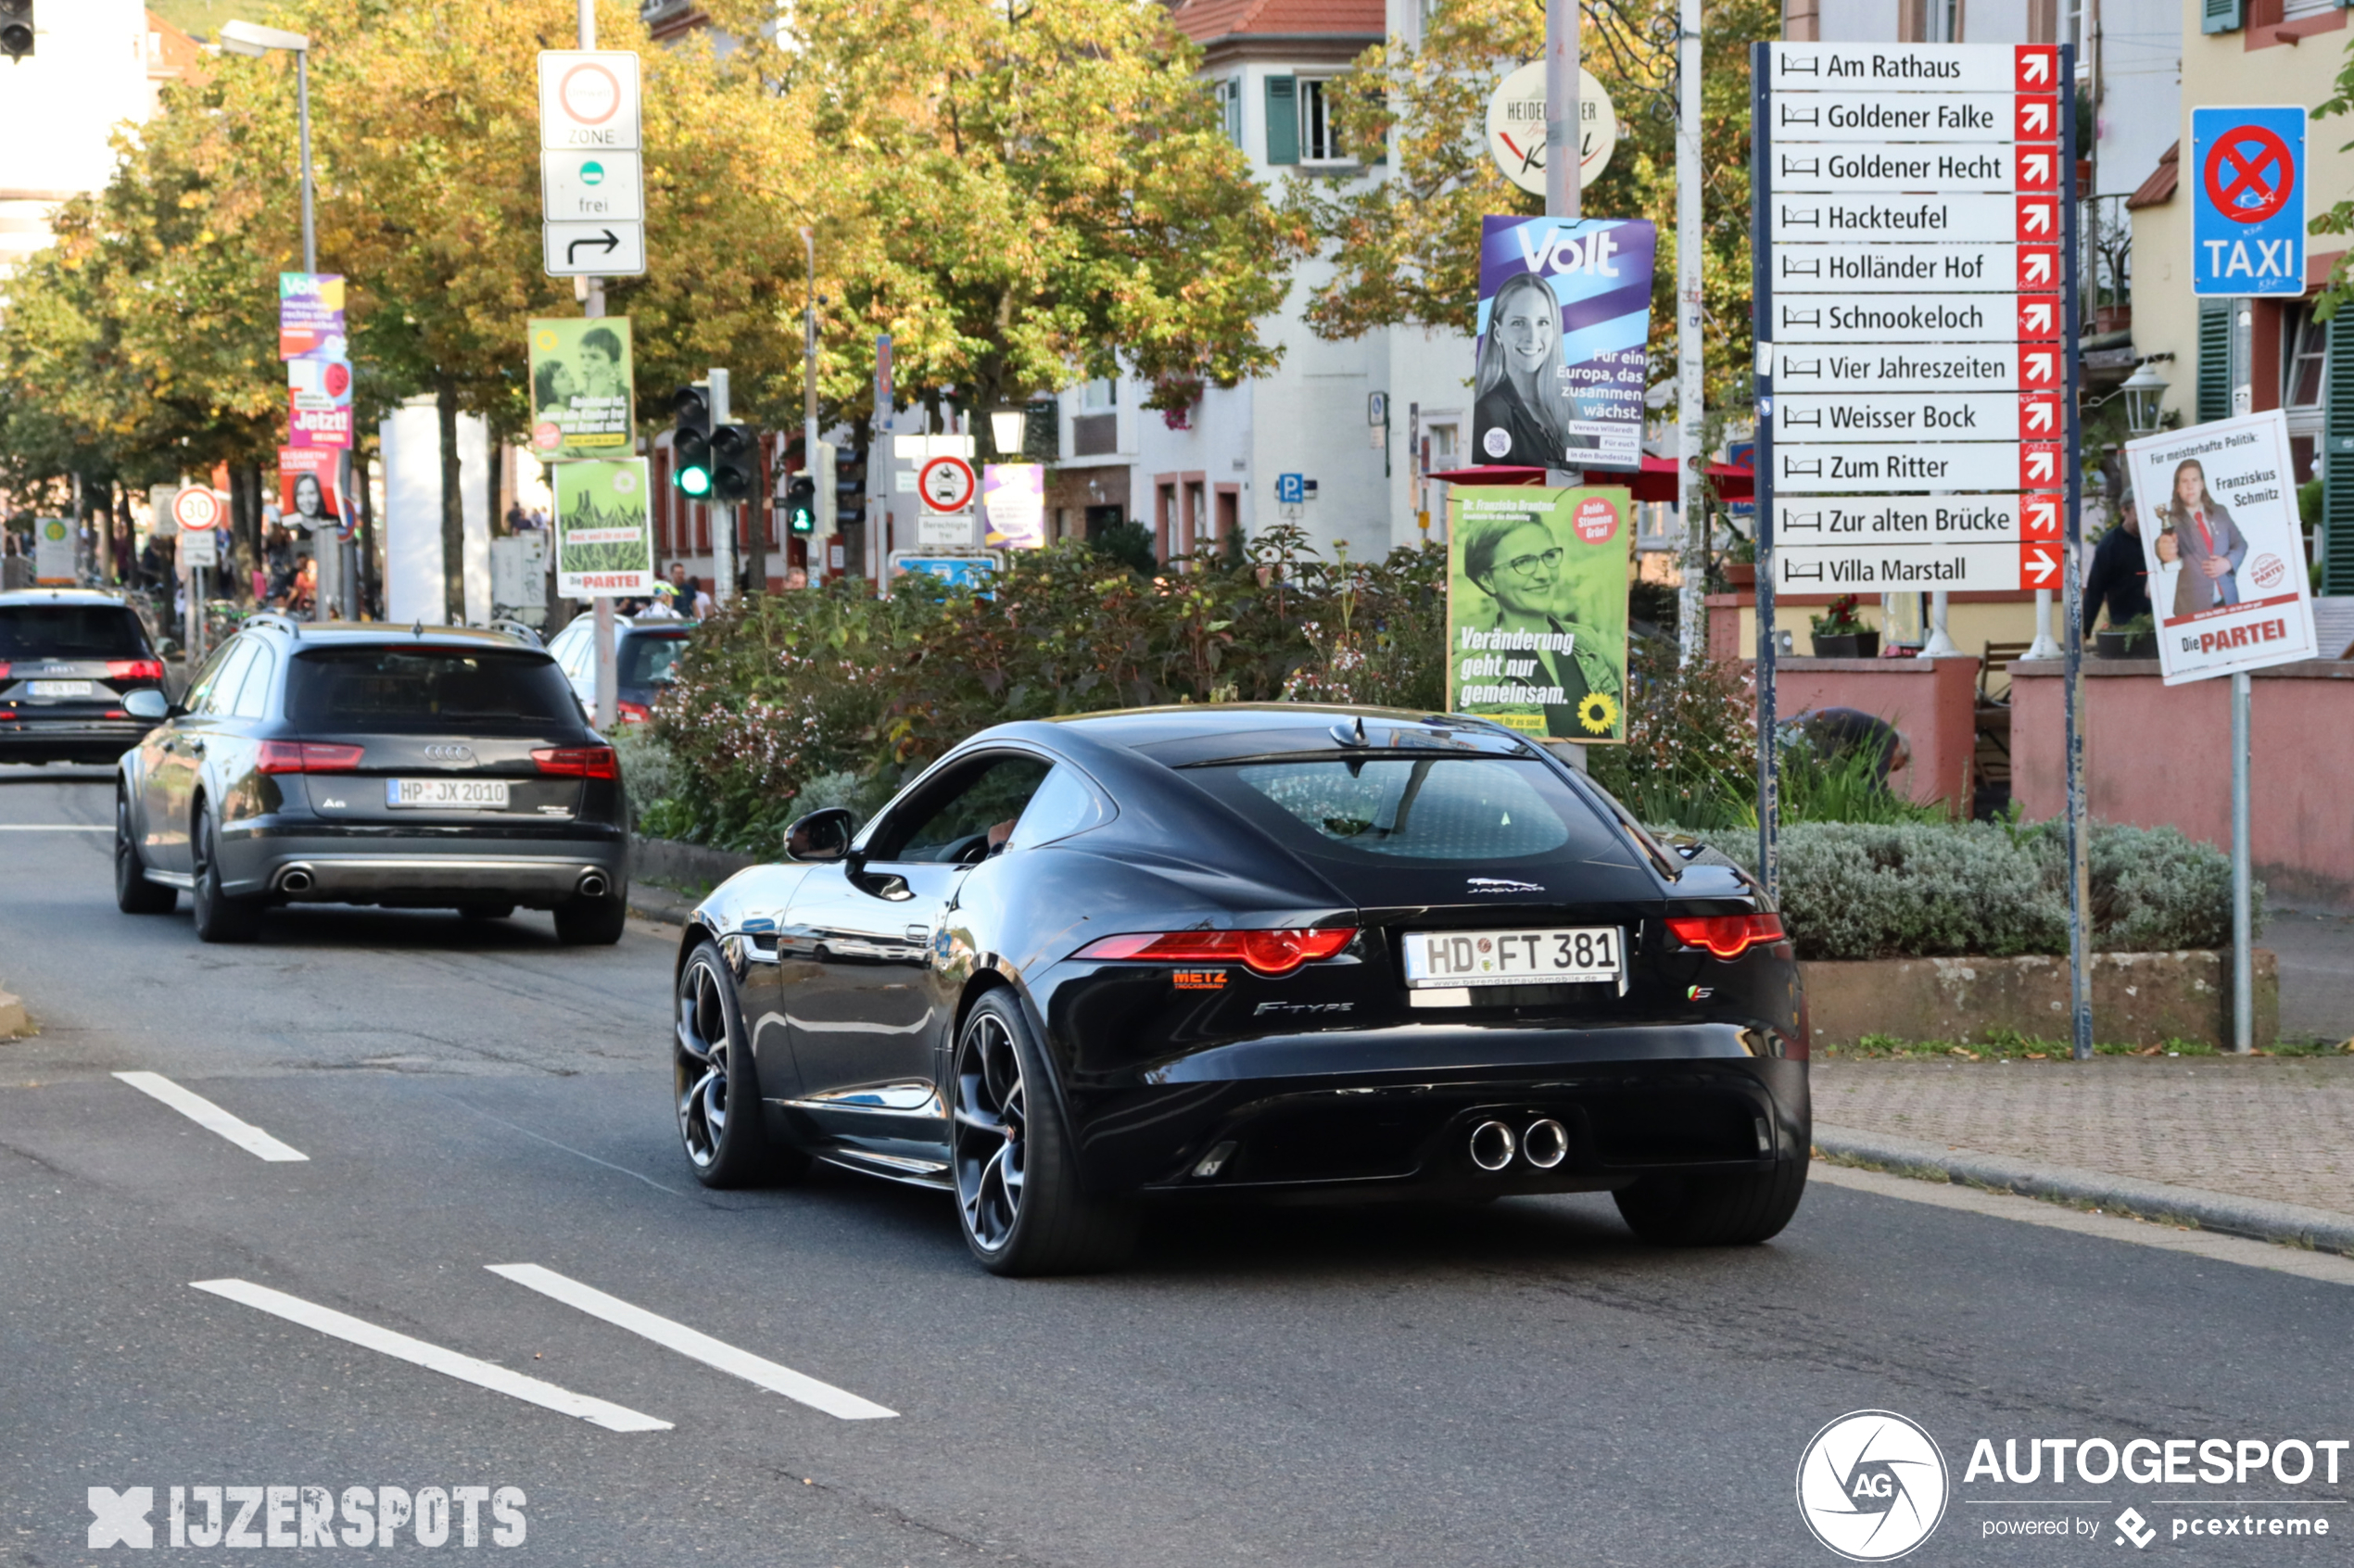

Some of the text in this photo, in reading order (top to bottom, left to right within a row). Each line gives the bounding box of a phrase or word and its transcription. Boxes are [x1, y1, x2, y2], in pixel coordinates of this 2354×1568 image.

[1828, 54, 1961, 78] Am Rathaus
[1828, 104, 1994, 129] Goldener Falke
[569, 130, 615, 145] ZONE
[1829, 154, 2002, 178] Goldener Hecht
[579, 196, 608, 212] frei
[1829, 204, 1946, 229] Hackteufel
[1516, 226, 1620, 278] Volt
[2203, 239, 2293, 278] TAXI
[1829, 254, 1983, 278] Holländer Hof
[283, 276, 322, 295] Volt
[1829, 304, 1983, 328] Schnookeloch
[1594, 348, 1644, 365] Für ein
[1557, 365, 1643, 384] Europa, das
[1829, 356, 2006, 378] Vier Jahreszeiten
[1561, 386, 1642, 401] zusammen
[294, 411, 348, 432] Jetzt!
[1583, 403, 1641, 421] wächst.
[1829, 404, 1976, 428] Weisser Bock
[1574, 424, 1634, 434] Verena Willaredt
[1619, 439, 1635, 448] euch
[2150, 432, 2259, 465] Für meisterhafte Politik:
[1579, 451, 1592, 460] den
[1830, 454, 1949, 478] Zum Ritter
[1285, 476, 1297, 499] P
[2215, 469, 2276, 491] Franziskus
[1462, 499, 1556, 512] Dr. Franziska Brantner
[2234, 488, 2280, 508] Schmitz
[184, 499, 209, 519] 30
[1582, 502, 1605, 516] Beide
[1829, 506, 2010, 532] Zur alten Brücke
[923, 521, 968, 531] Berechtigte
[1578, 513, 1613, 528] Stimmen
[1586, 525, 1607, 538] Grün!
[1829, 556, 1965, 582] Villa Marstall
[569, 575, 639, 588] Die PARTEI
[1461, 626, 1575, 656] Veränderung
[2182, 636, 2200, 652] Die
[2200, 618, 2287, 654] PARTEI
[1460, 653, 1538, 681] geht nur
[1459, 681, 1569, 708] gemeinsam.
[1525, 717, 1542, 727] seid.
[400, 782, 504, 802] HP JX 2010
[323, 798, 347, 808] A6
[1427, 932, 1616, 973] HD FT 381
[1173, 969, 1227, 983] METZ
[1433, 975, 1598, 987] www.berendsenautomobile.de
[1253, 1001, 1355, 1016] F-TYPE
